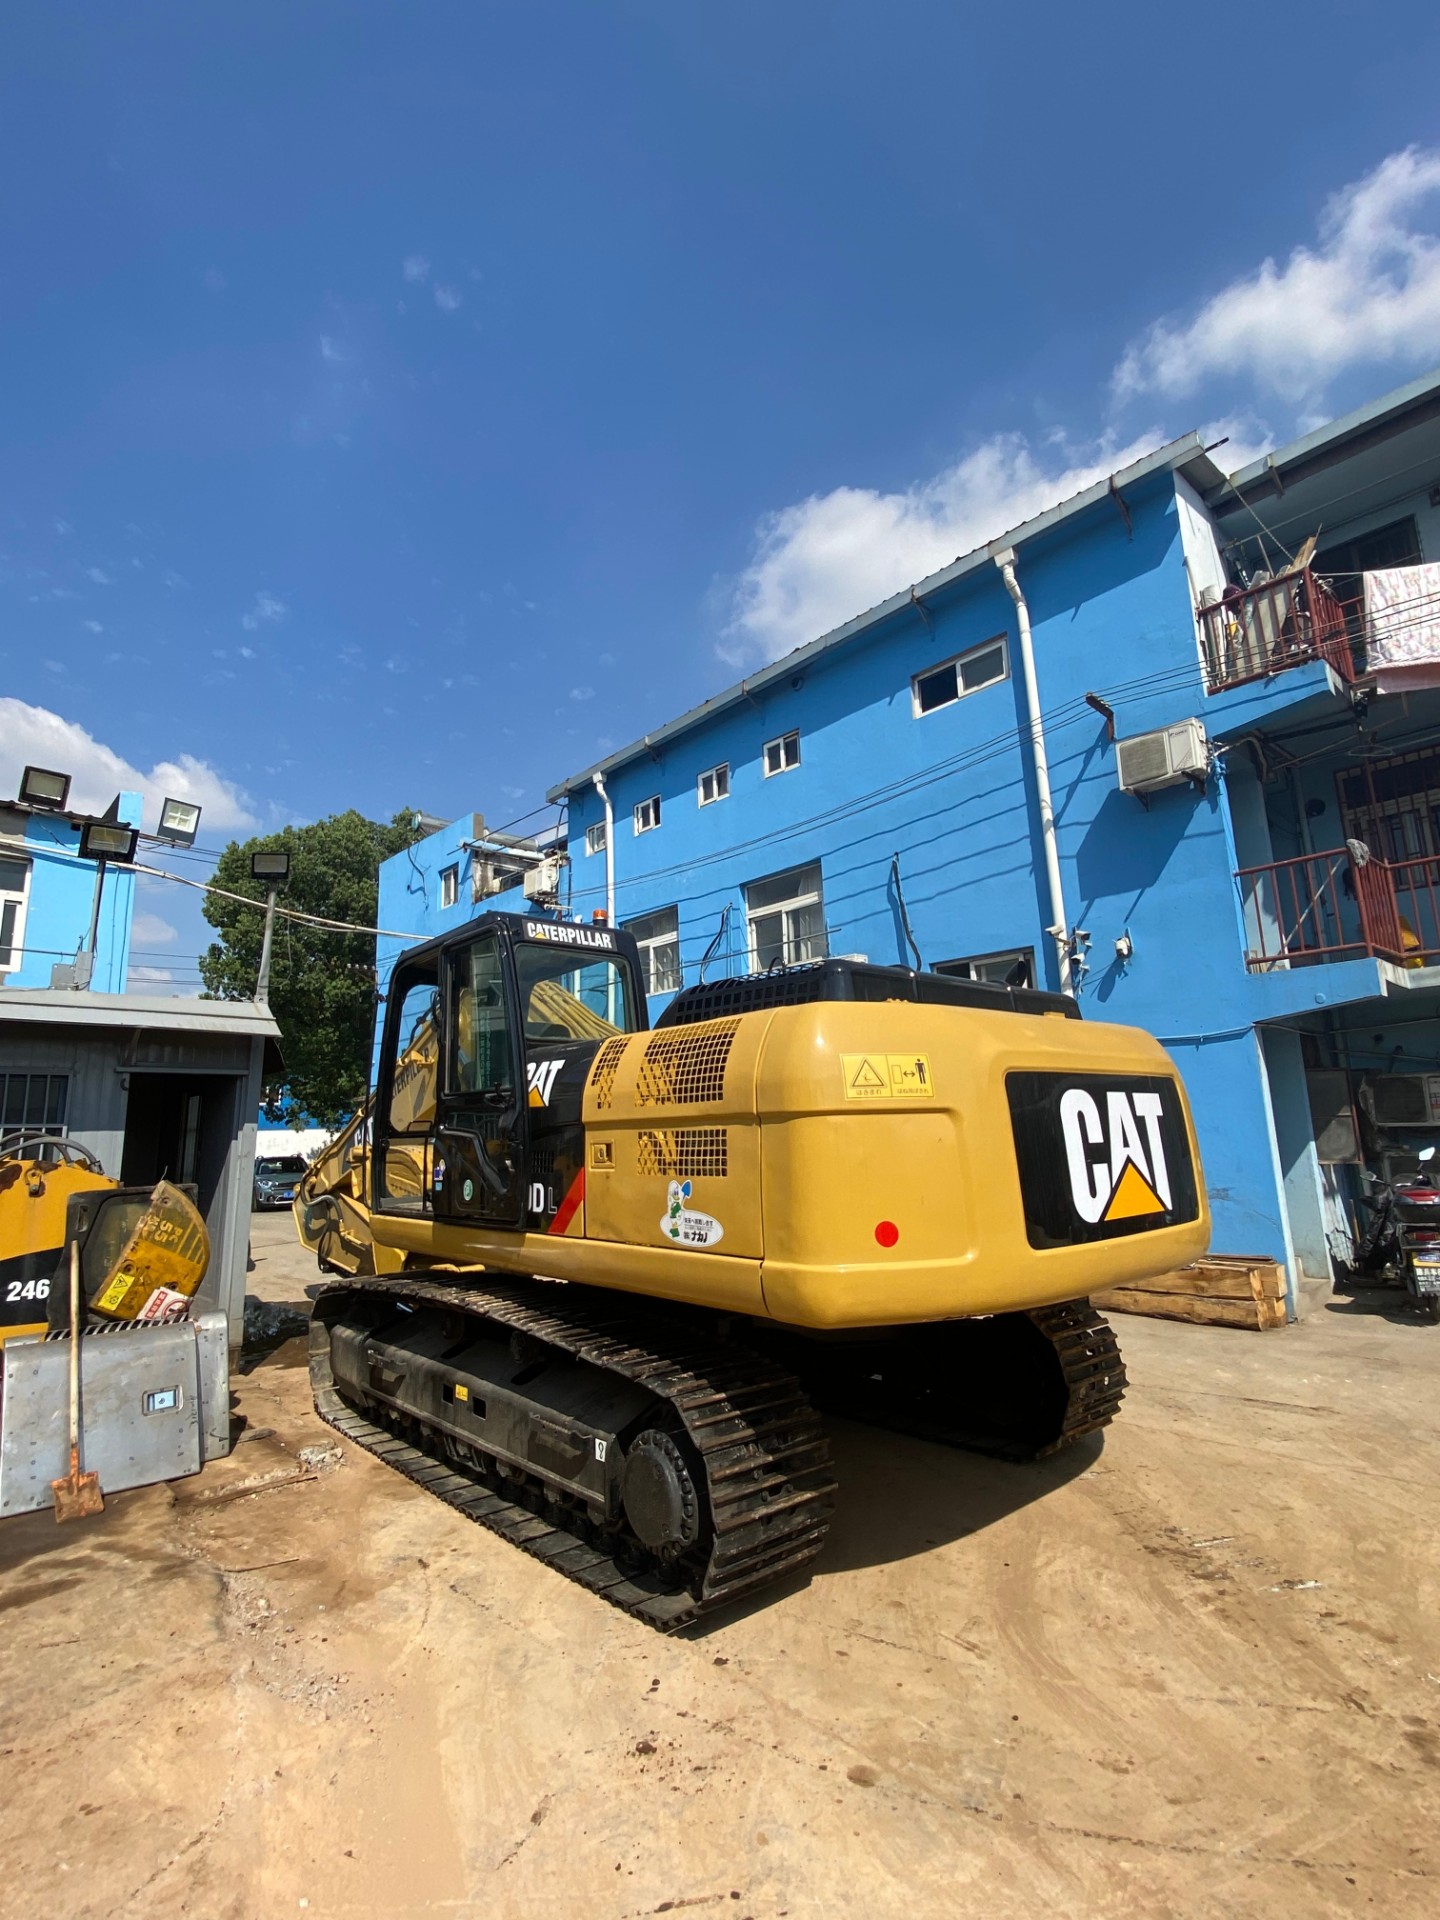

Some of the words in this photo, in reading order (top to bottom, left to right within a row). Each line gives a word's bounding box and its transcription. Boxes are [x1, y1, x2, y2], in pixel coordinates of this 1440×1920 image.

[527, 922, 612, 948] CATERPILLAR
[1060, 1089, 1173, 1224] CAT
[154, 1220, 174, 1243] 55
[5, 1278, 51, 1302] 246
